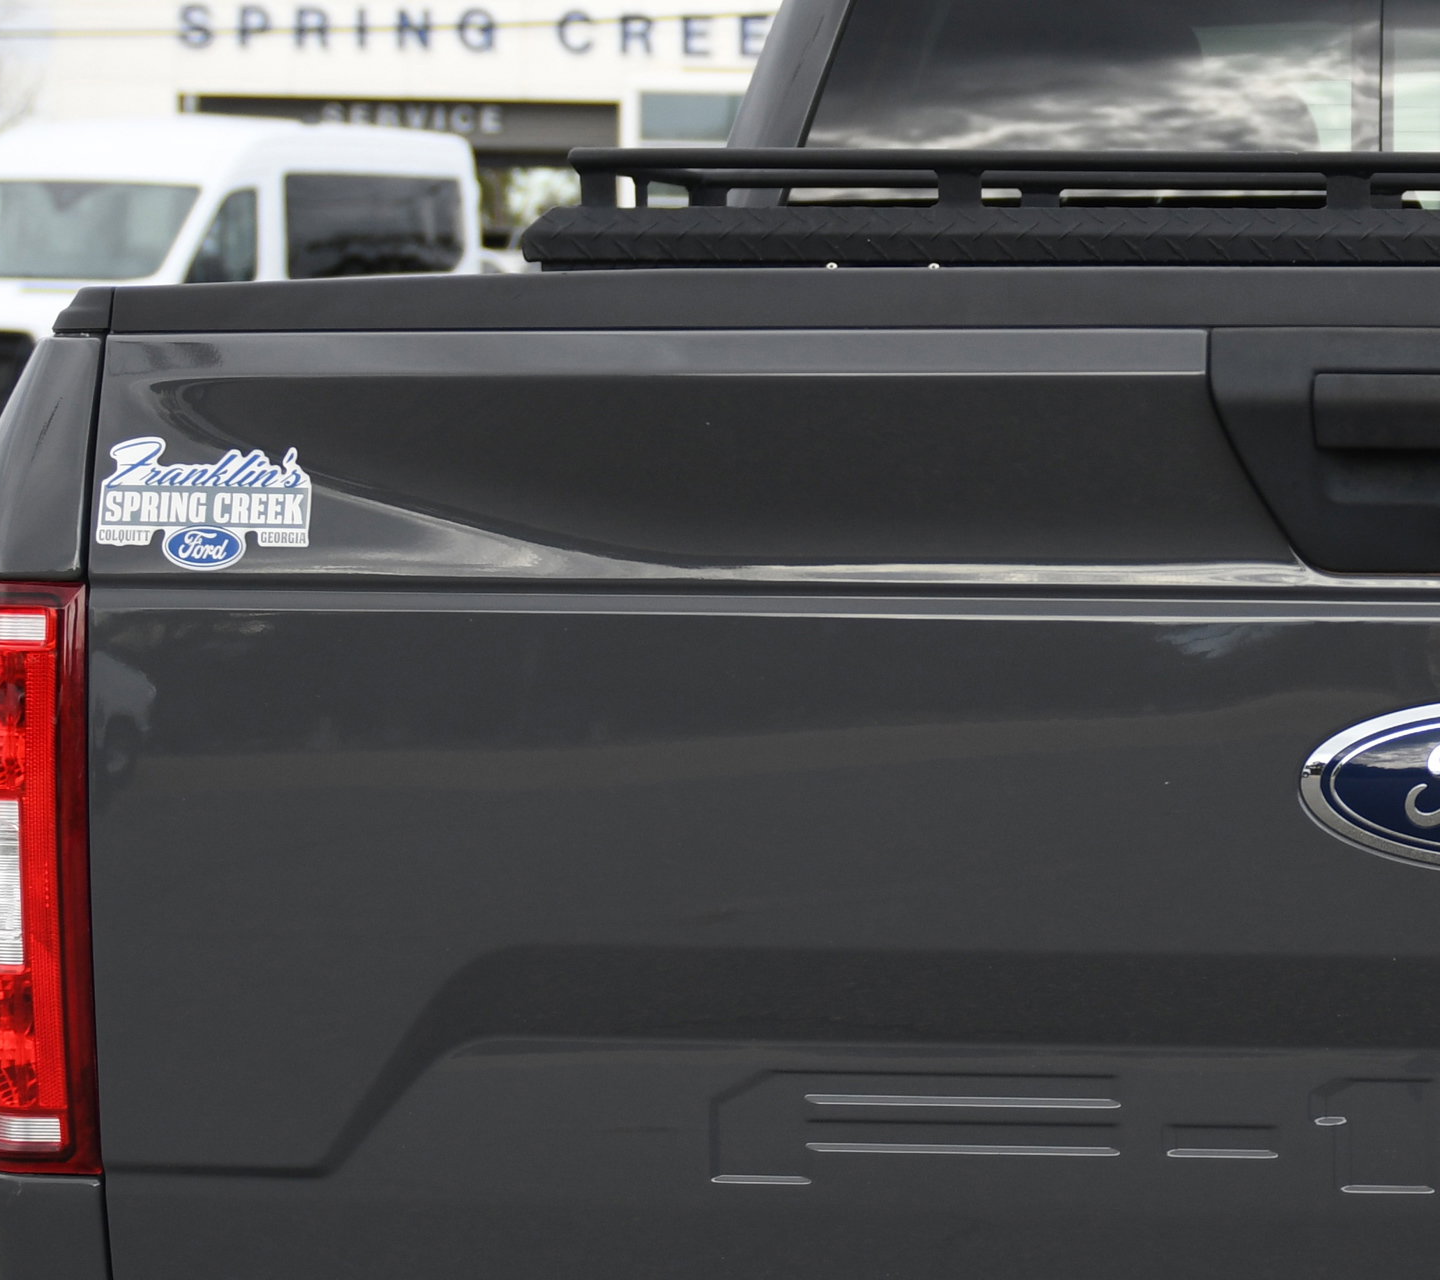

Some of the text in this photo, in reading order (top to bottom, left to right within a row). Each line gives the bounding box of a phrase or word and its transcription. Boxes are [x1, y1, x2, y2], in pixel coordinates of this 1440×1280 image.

[178, 4, 496, 52] SPRING
[322, 102, 503, 134] SERVICE
[106, 440, 308, 489] Franklin's
[105, 491, 304, 525] SPRING CREEK
[98, 528, 151, 543] COLQUITT
[179, 530, 228, 560] Ford
[260, 531, 307, 544] GEORGIA
